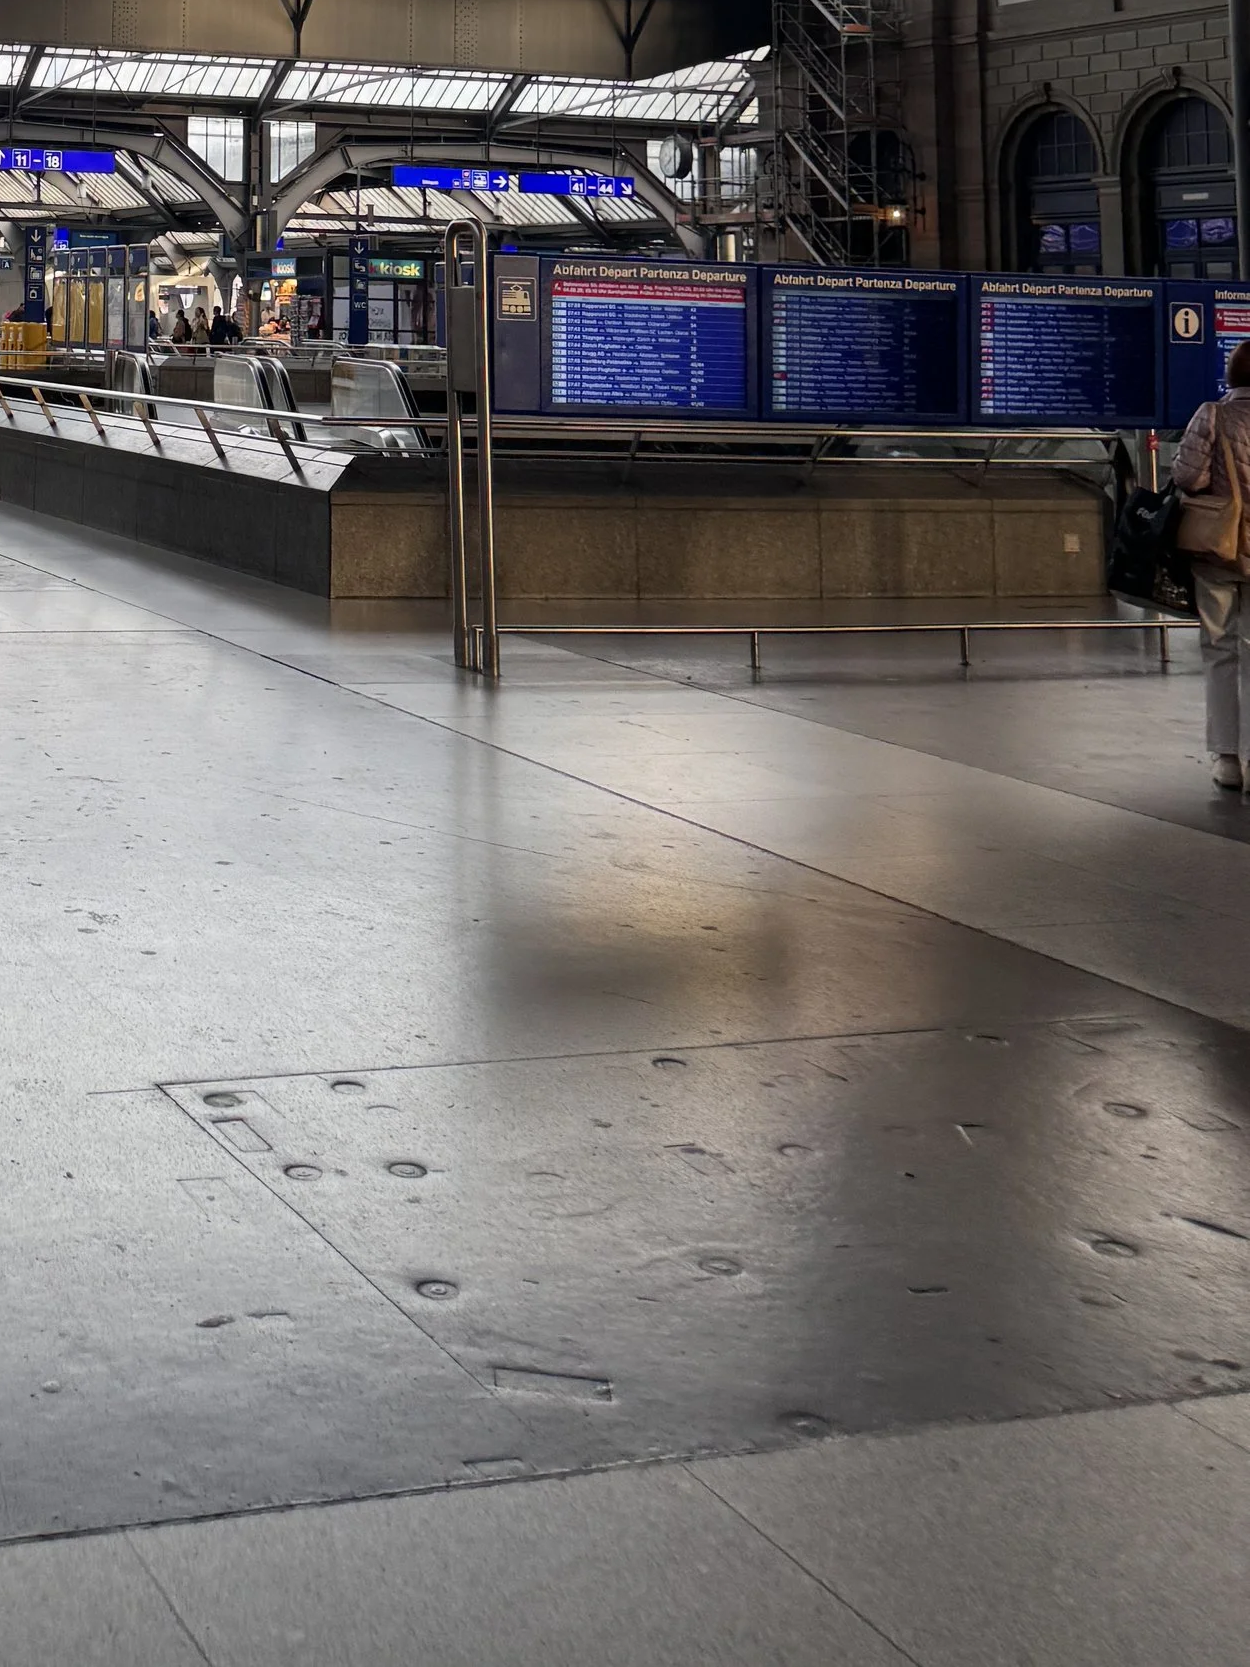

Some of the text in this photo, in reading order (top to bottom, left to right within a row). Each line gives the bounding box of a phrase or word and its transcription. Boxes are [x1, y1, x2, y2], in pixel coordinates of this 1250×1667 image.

[15, 154, 27, 166] 11
[45, 155, 60, 168] 18
[572, 182, 584, 193] 41
[599, 183, 613, 194] 44
[379, 261, 421, 277] kiosk
[553, 264, 747, 283] Abfahrt Départ Partenza Departure
[774, 274, 814, 286] Abfahrt
[855, 277, 902, 289] Partenza
[905, 278, 957, 292] Departure
[982, 281, 1019, 293] Abfahrt
[1058, 284, 1102, 296] Partenza
[1104, 286, 1153, 298] Departure
[354, 301, 367, 309] WC
